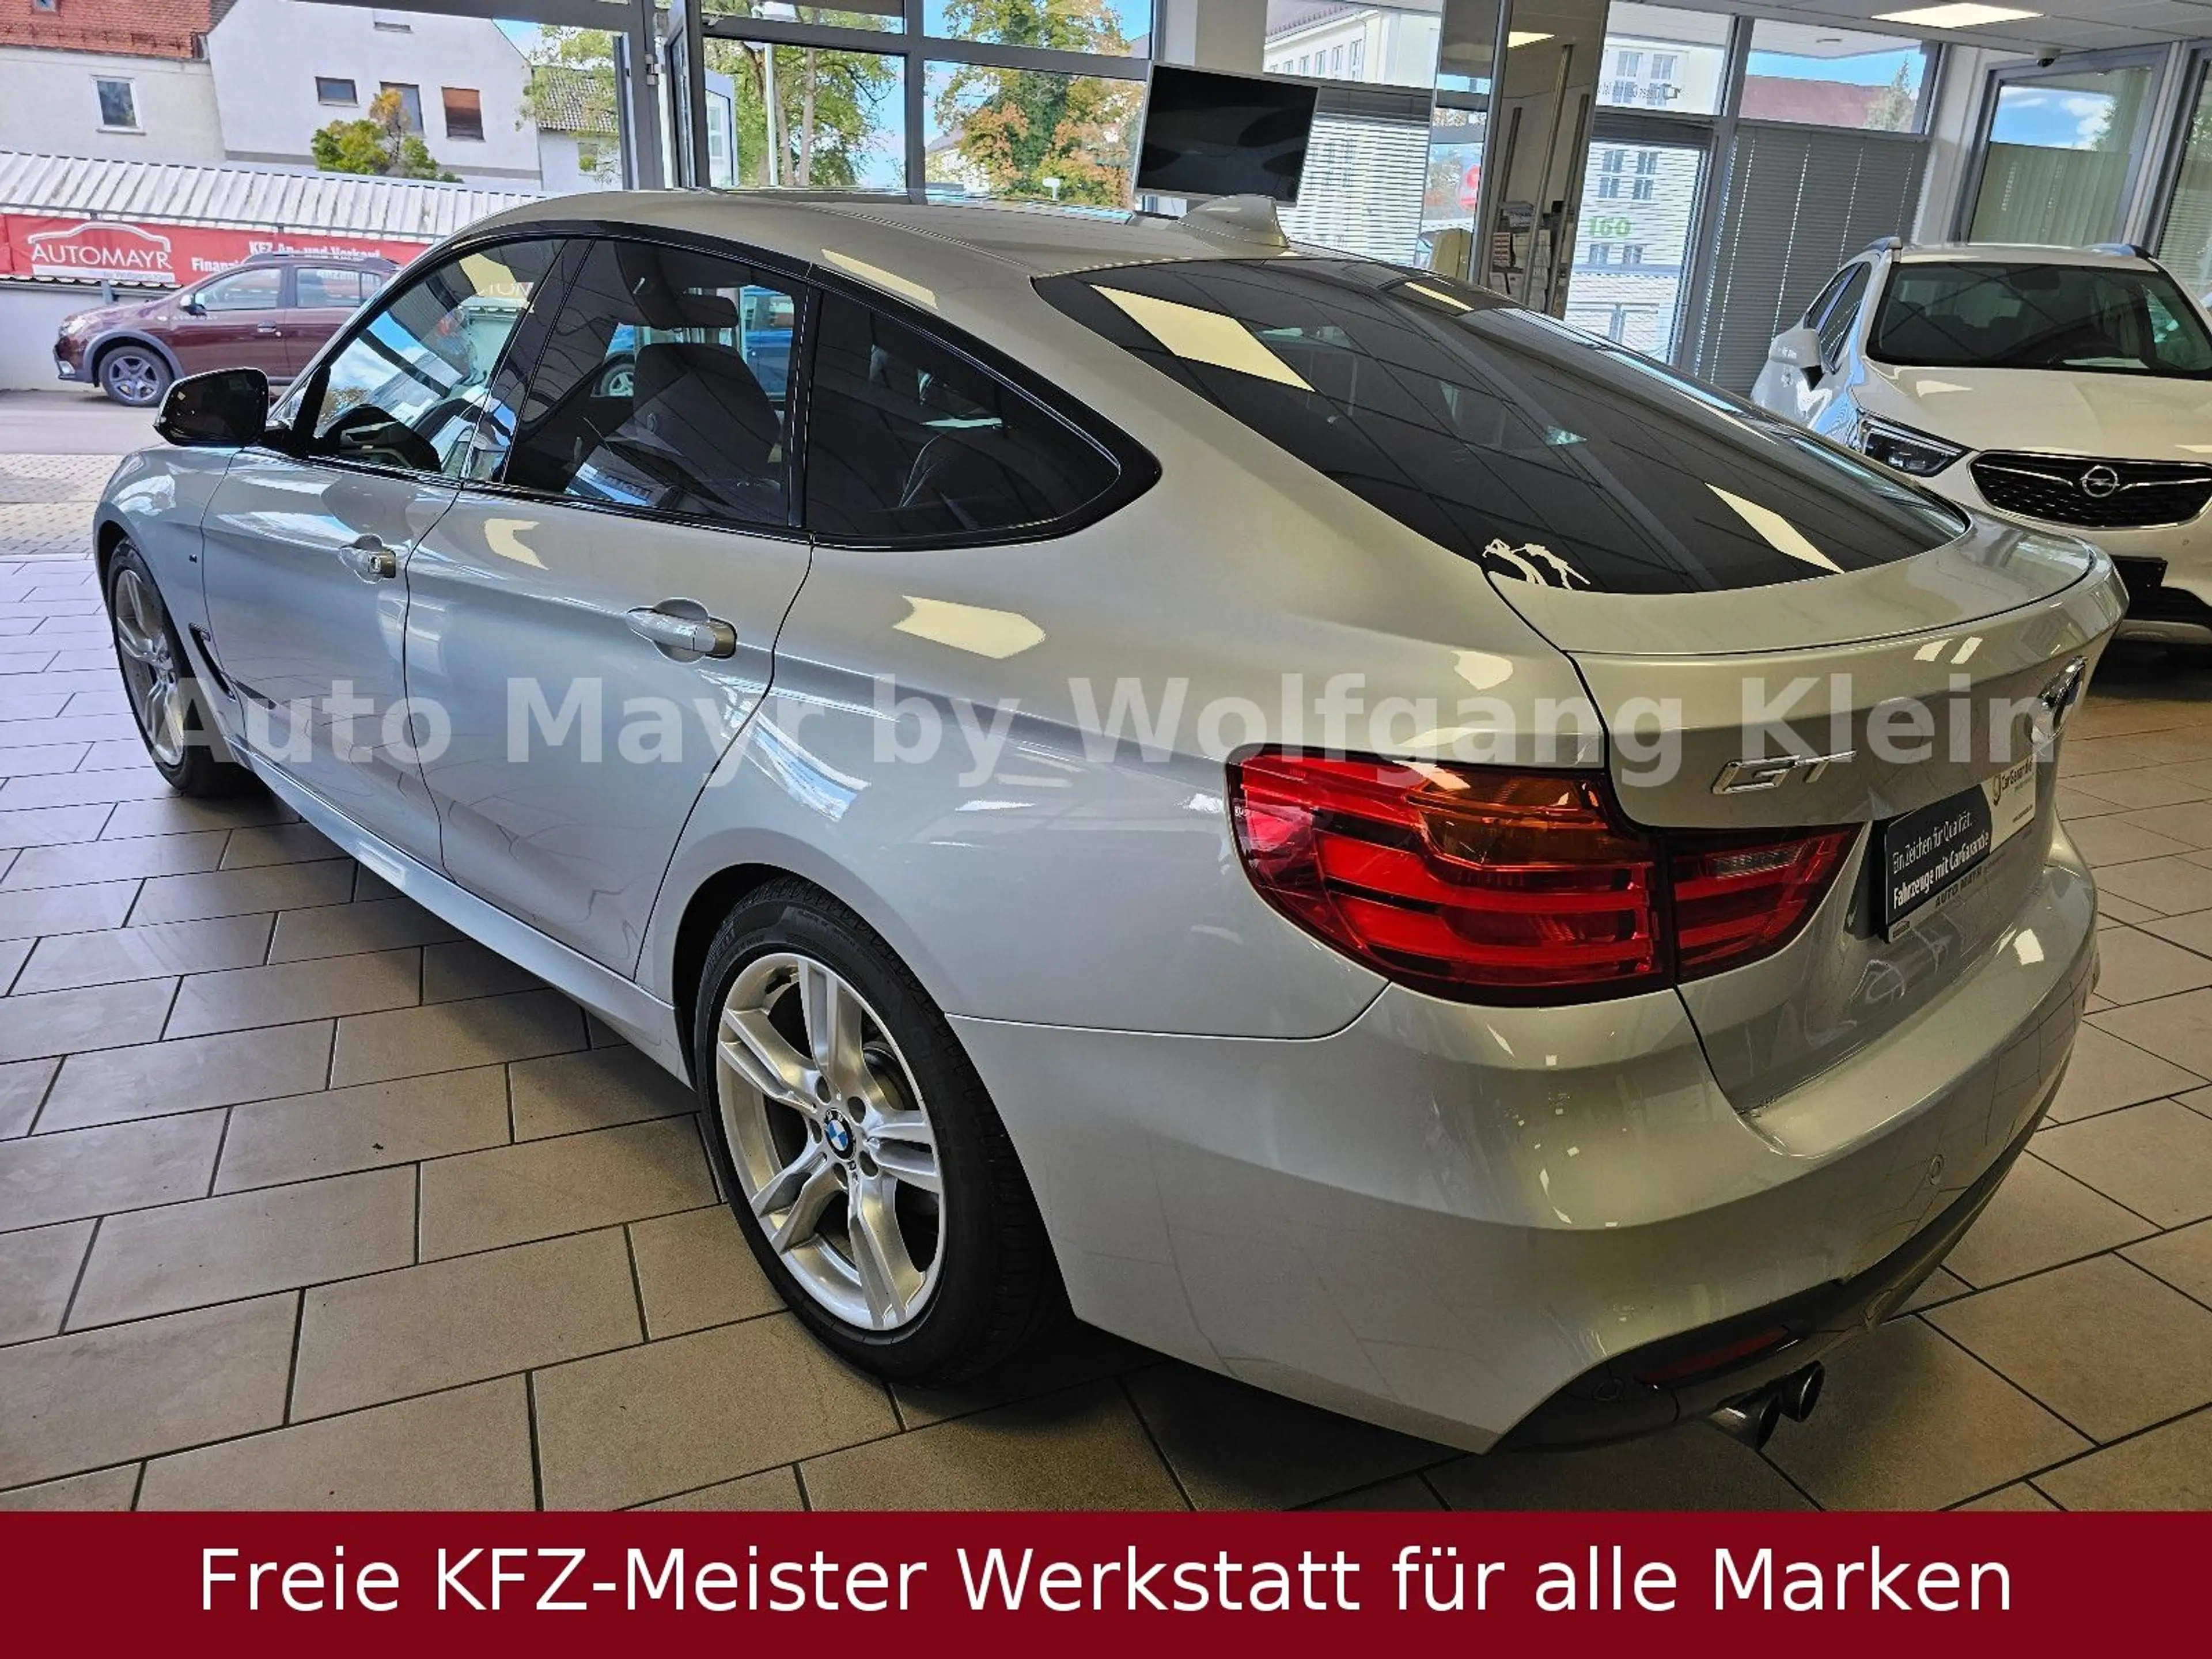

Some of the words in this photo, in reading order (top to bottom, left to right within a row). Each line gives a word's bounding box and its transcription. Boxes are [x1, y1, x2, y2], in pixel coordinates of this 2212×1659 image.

[32, 243, 173, 270] AUTOMAYR
[249, 240, 273, 256] KFZ
[1711, 749, 1857, 794] GT
[1892, 851, 1905, 874] Ein
[1904, 836, 1932, 867] Zeichen
[1893, 869, 1934, 910] Fahrzeuge
[1935, 856, 1949, 882] mit
